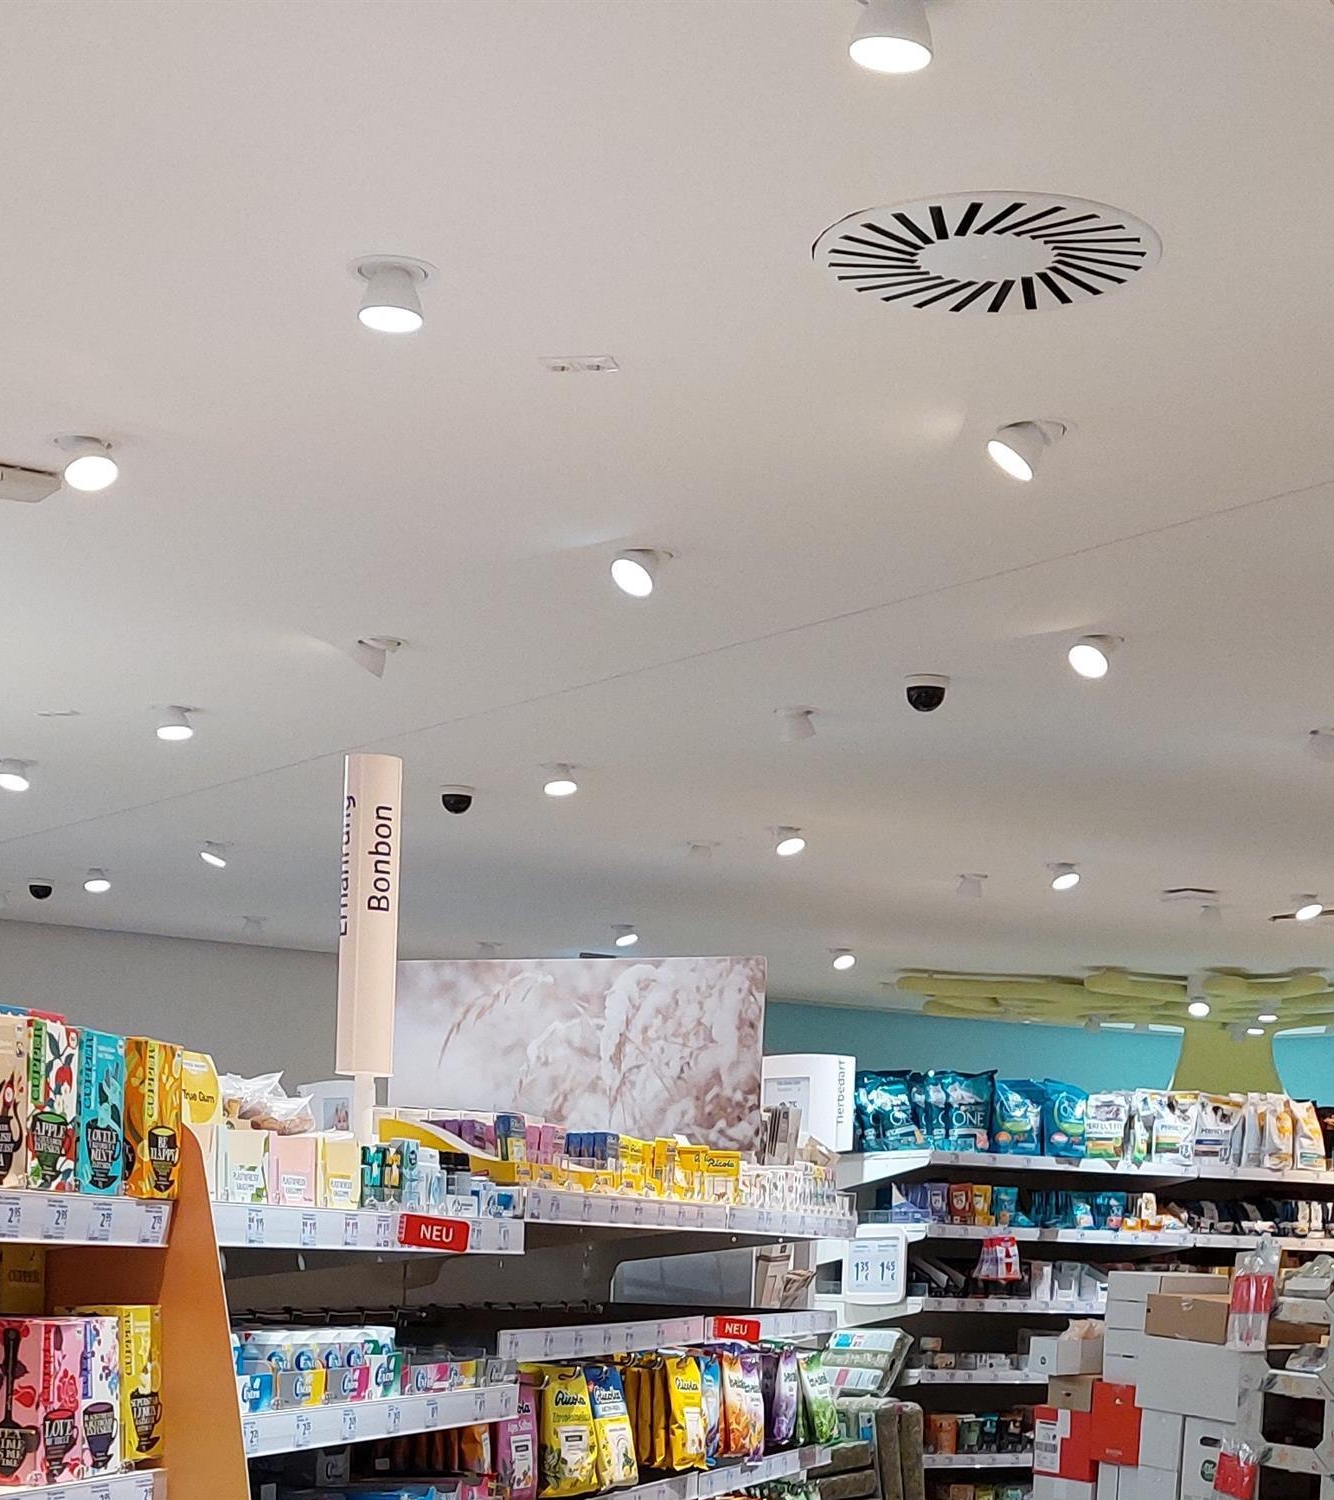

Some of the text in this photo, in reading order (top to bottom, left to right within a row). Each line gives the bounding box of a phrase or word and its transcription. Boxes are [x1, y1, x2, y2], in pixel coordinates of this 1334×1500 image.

[367, 804, 393, 912] Bonbon
[952, 1109, 985, 1127] ONE
[419, 1224, 454, 1243] NEU
[724, 1323, 748, 1336] NEU
